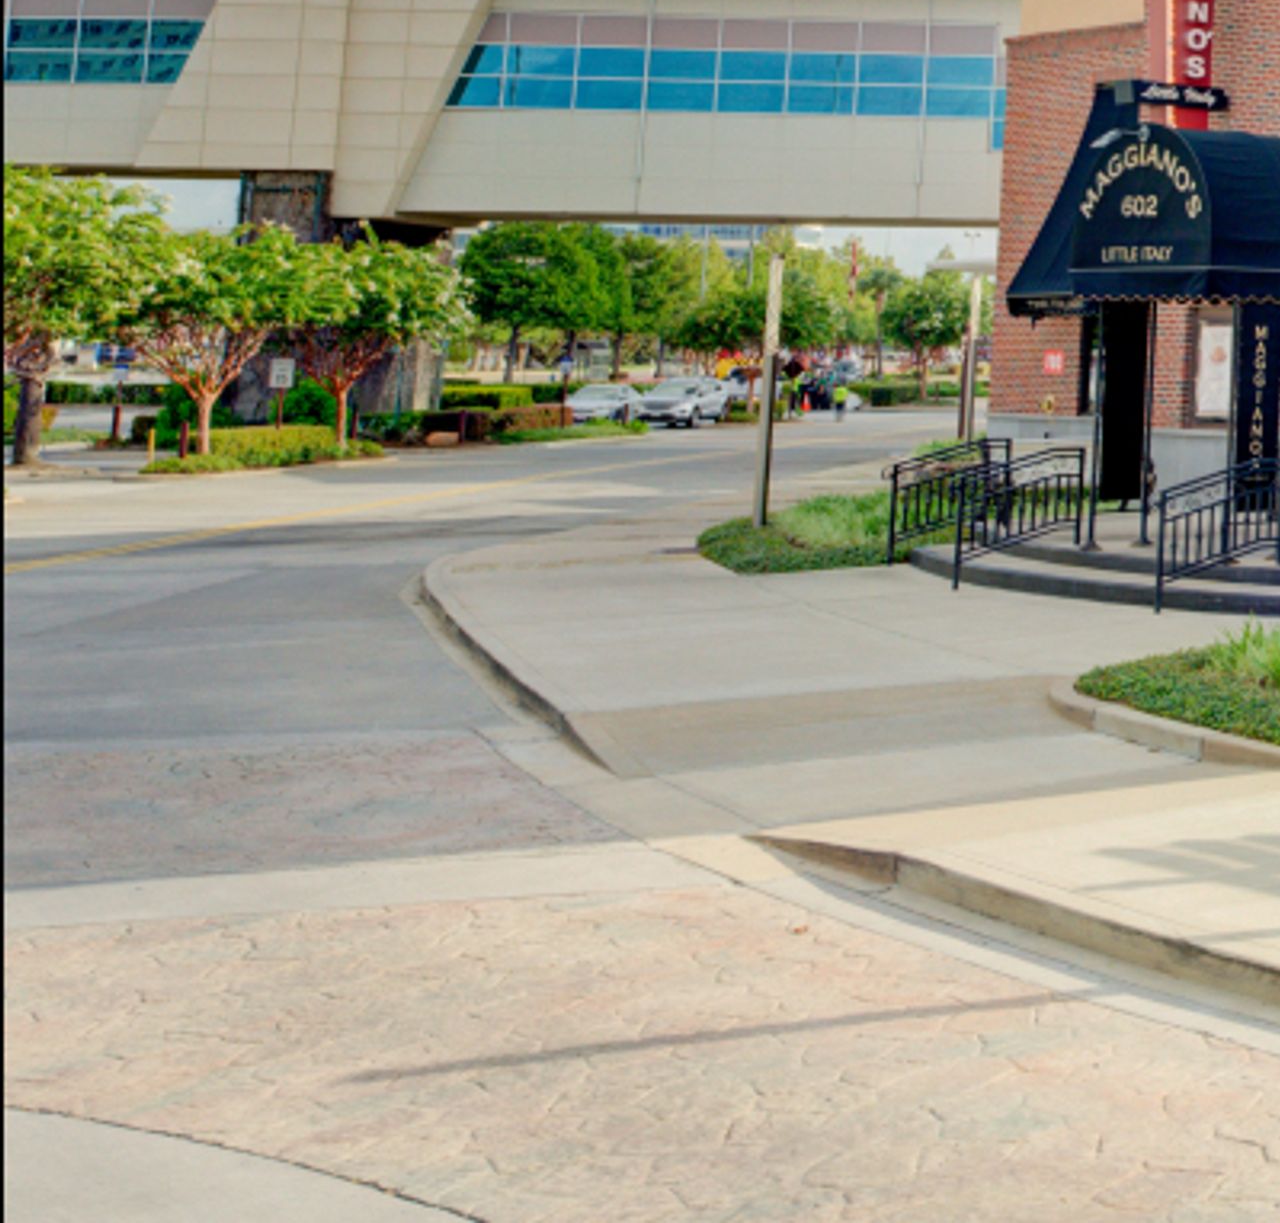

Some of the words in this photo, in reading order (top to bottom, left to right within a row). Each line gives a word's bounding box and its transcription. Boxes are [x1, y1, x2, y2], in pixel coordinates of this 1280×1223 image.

[1080, 142, 1202, 219] MAGGIANO'S
[1120, 194, 1158, 218] 602
[1101, 245, 1138, 263] LITTLE
[1141, 245, 1173, 262] ITALY
